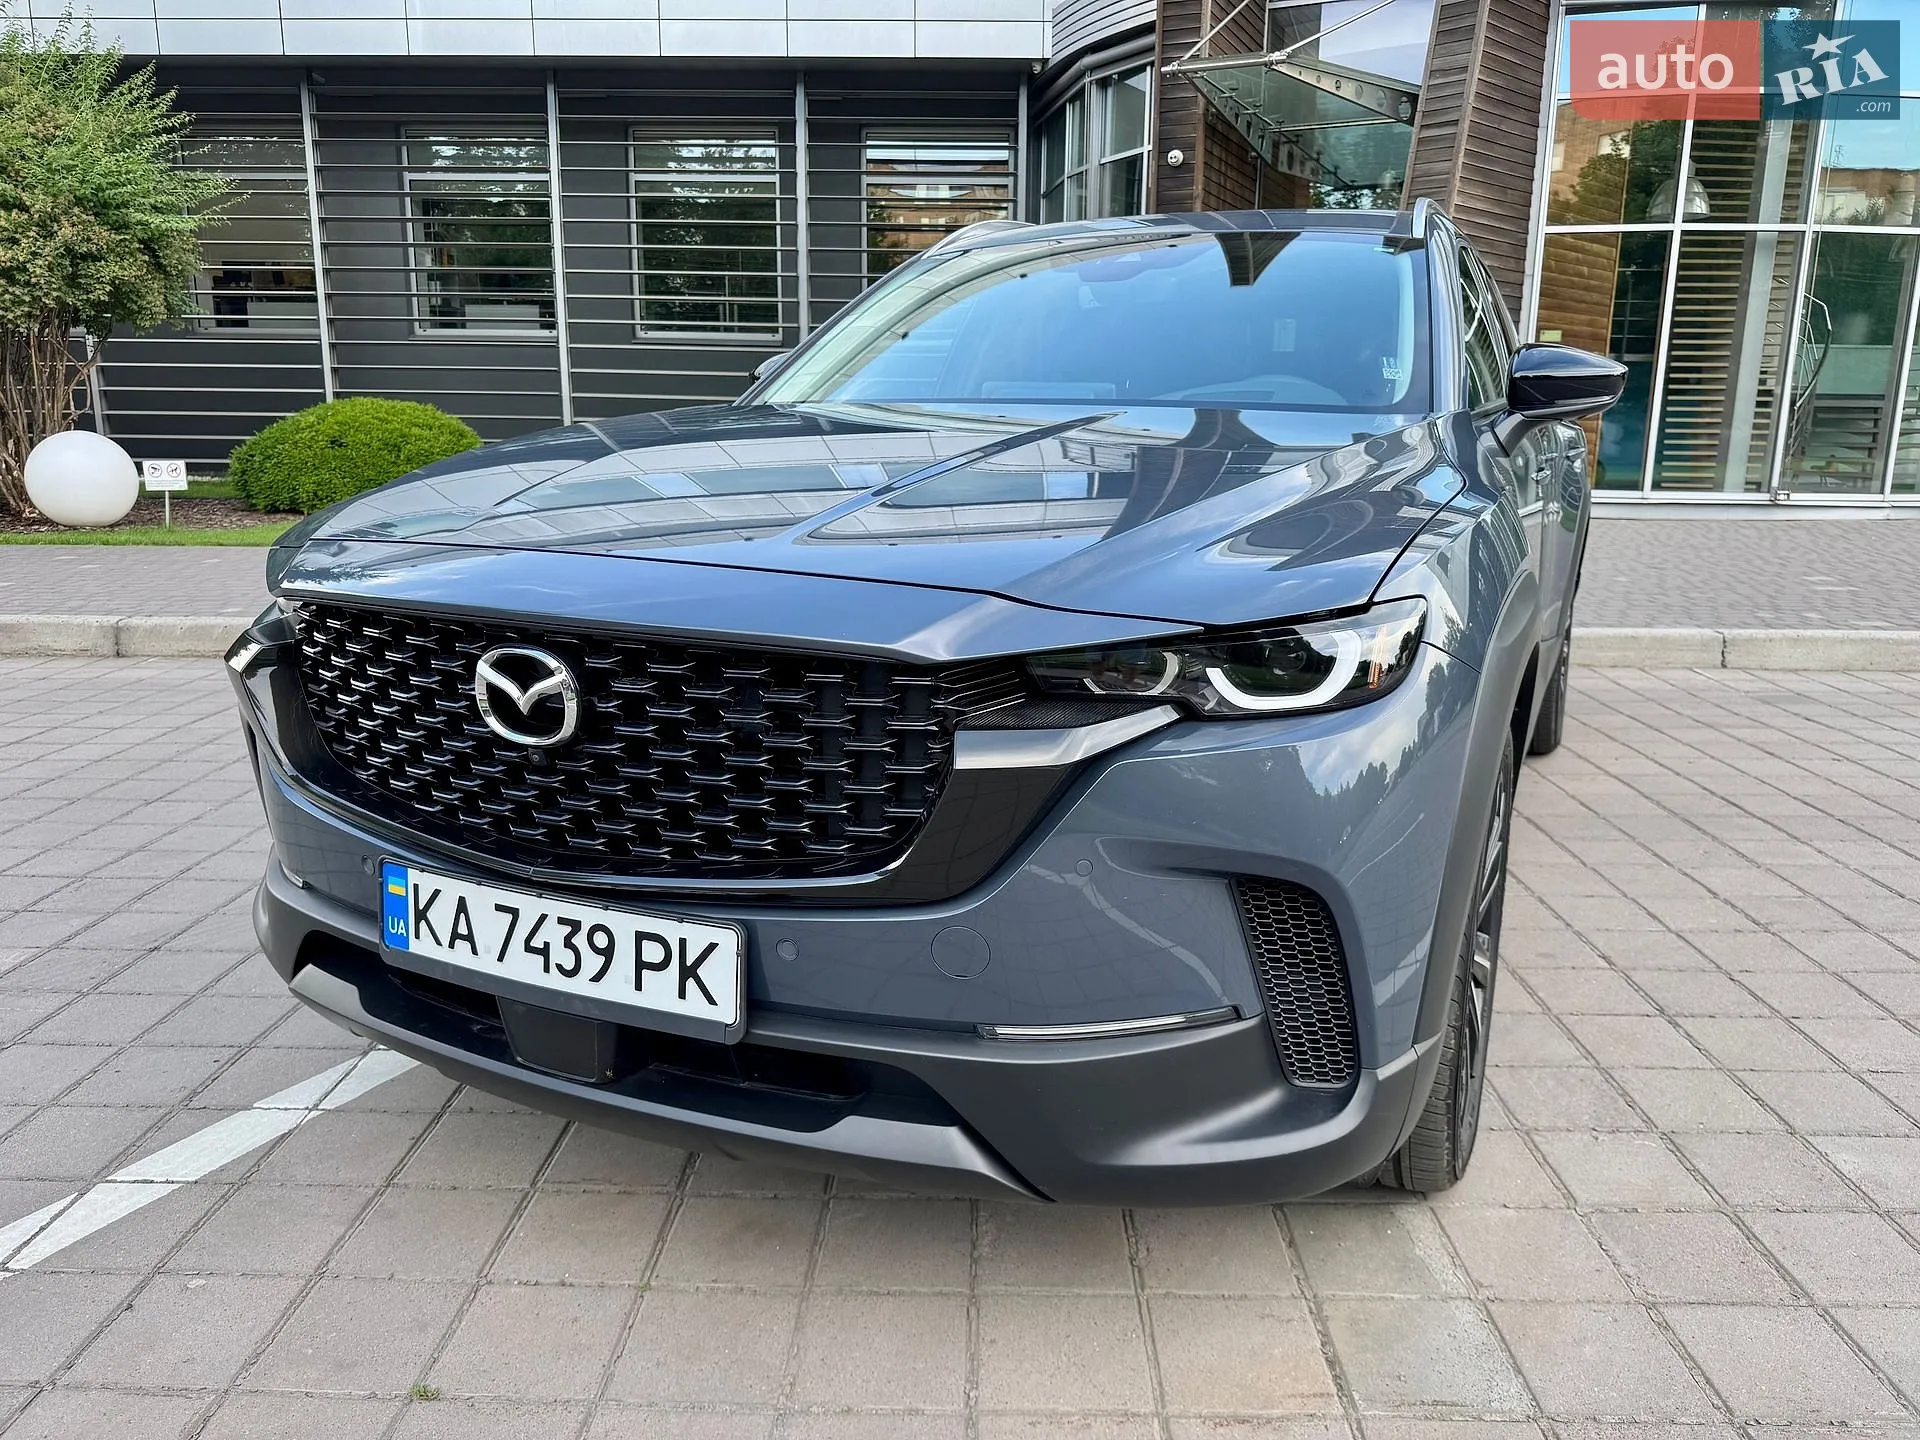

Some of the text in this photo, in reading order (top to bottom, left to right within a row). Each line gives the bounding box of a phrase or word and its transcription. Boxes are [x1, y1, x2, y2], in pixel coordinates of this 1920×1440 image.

[388, 915, 407, 937] UA
[412, 883, 719, 1006] KA 7439 PK
